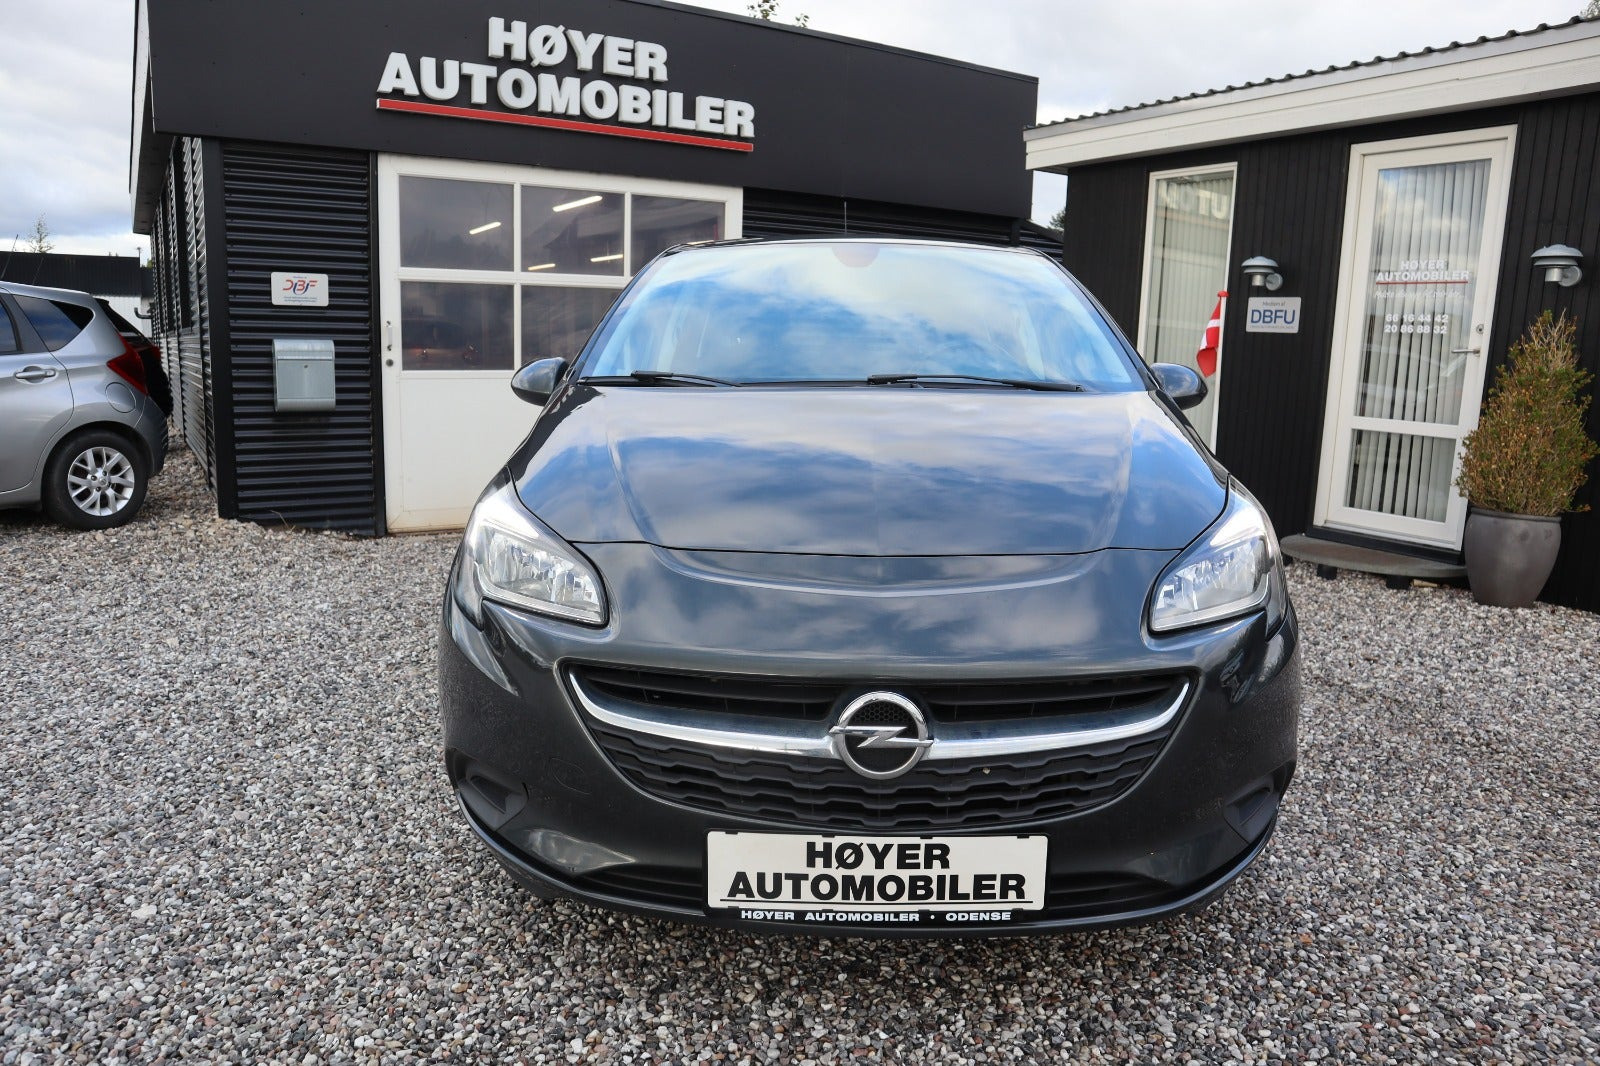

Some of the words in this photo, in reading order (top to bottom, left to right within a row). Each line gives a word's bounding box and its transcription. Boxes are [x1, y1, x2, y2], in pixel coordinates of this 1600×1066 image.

[488, 16, 668, 82] HØYER
[377, 51, 755, 138] AUTOMOBILER
[1376, 270, 1469, 281] AUTOMOBILER
[1250, 309, 1296, 324] DBFU
[1434, 314, 1449, 323] 42
[1384, 325, 1398, 333] 20
[1433, 325, 1448, 334] 32
[806, 842, 950, 870] HØYER
[727, 871, 1026, 901] AUTOMOBILER
[741, 910, 795, 921] HØYER
[804, 912, 920, 922] AUTOMOBILER
[945, 912, 1012, 922] ODENSE
